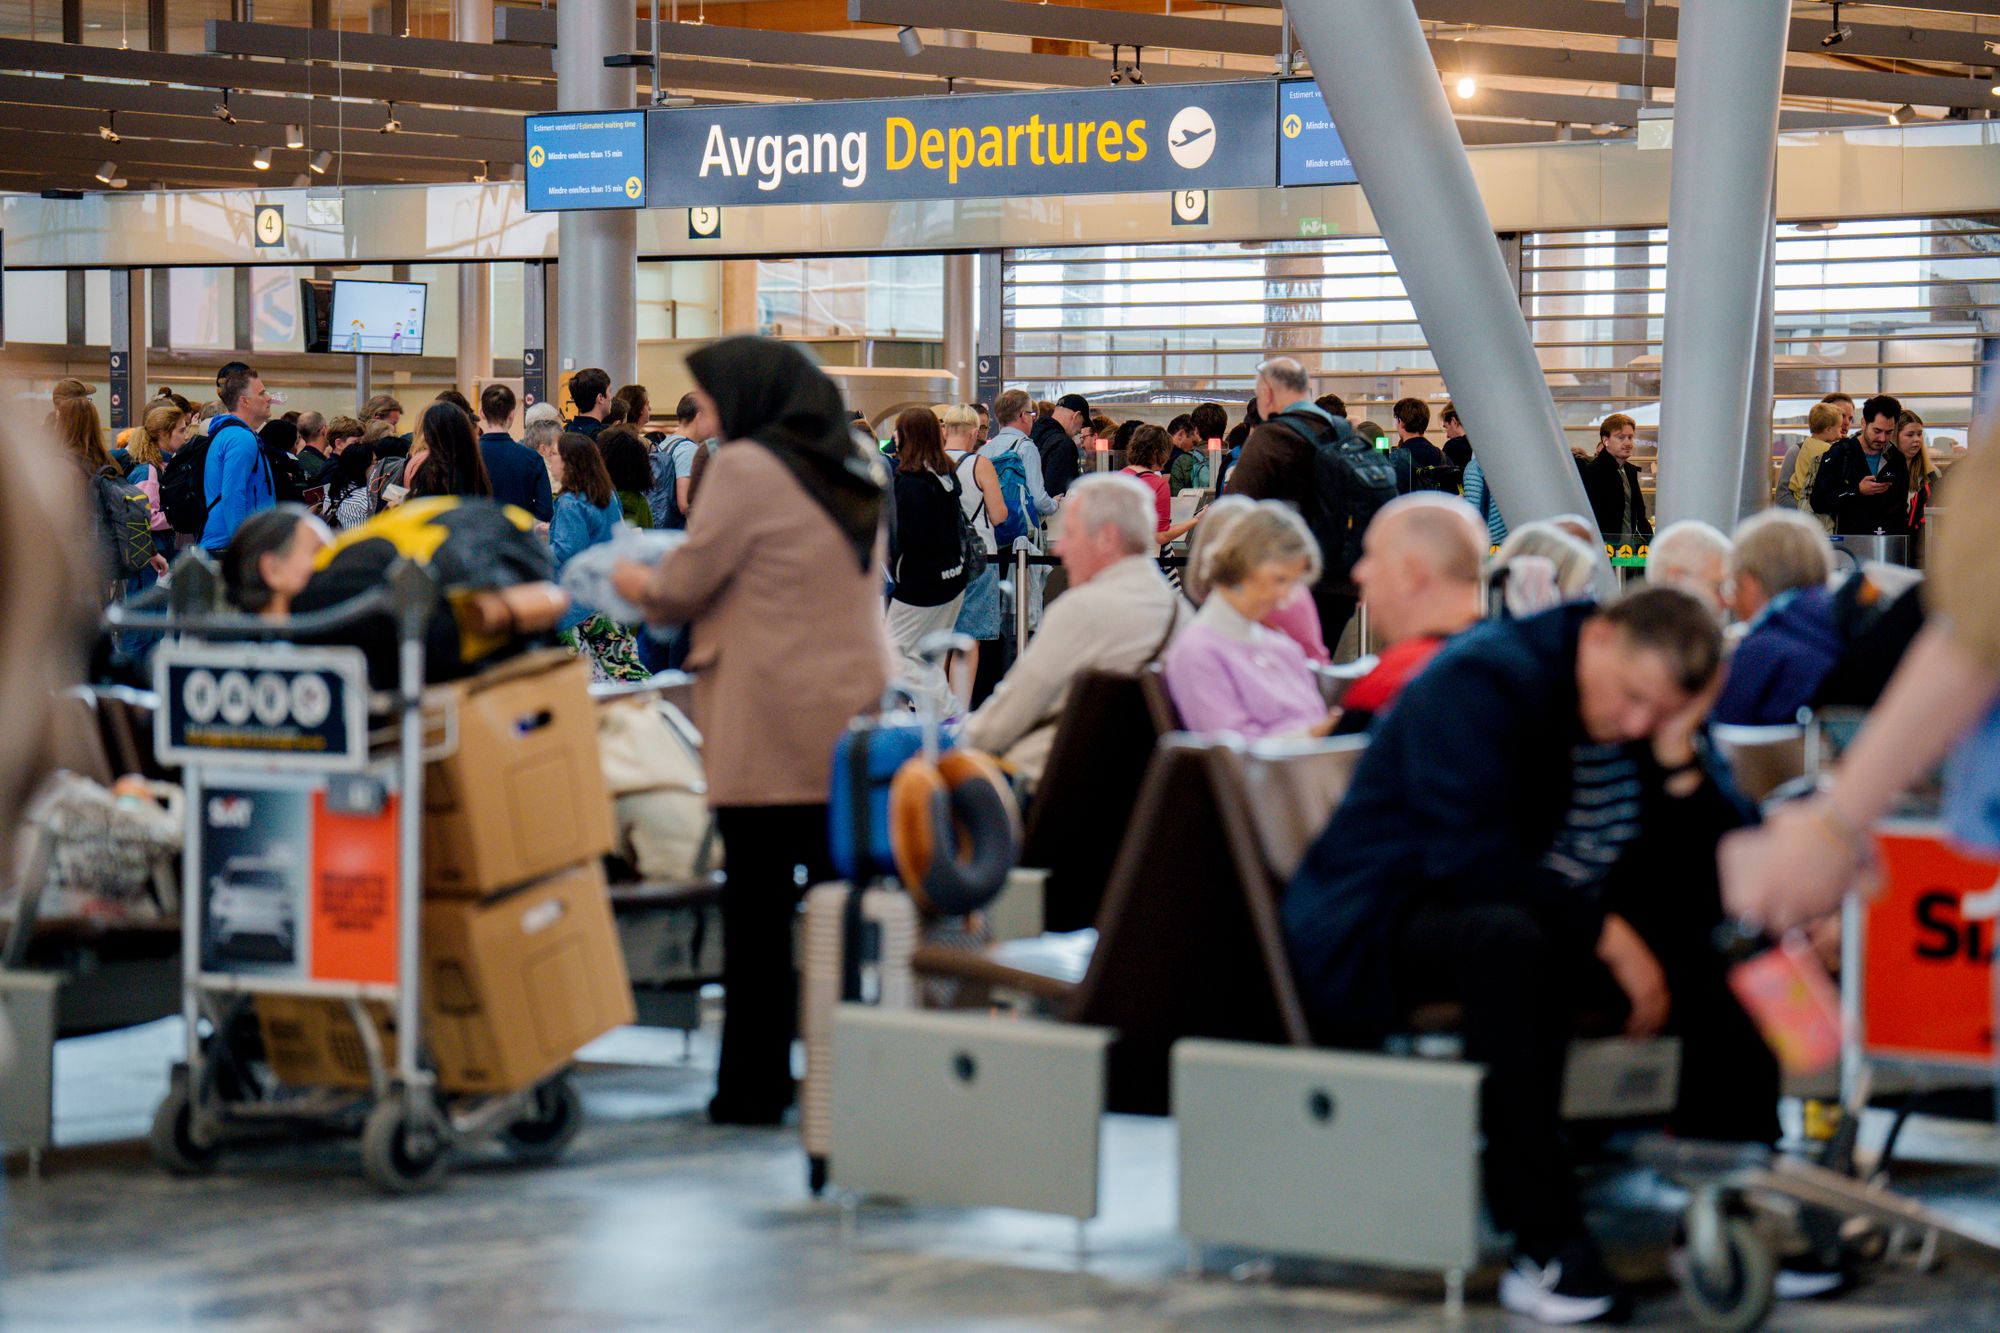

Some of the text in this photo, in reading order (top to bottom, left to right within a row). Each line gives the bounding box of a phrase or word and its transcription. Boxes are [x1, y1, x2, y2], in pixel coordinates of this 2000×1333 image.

[1289, 91, 1314, 99] Estimert
[534, 124, 555, 132] Estimert
[555, 123, 576, 131] ventetid
[604, 121, 623, 130] waiting
[1305, 121, 1328, 130] Mindre
[548, 152, 567, 160] Mindre
[590, 150, 603, 158] than
[604, 150, 611, 158] 15
[611, 149, 623, 157] min
[699, 114, 1147, 190] Avgang Departures
[1305, 159, 1328, 168] Mindre
[548, 187, 568, 195] Mindre
[590, 185, 604, 193] than
[604, 185, 611, 193] 15
[612, 184, 623, 192] min
[1185, 190, 1195, 209] 6
[700, 206, 709, 224] 5
[265, 215, 274, 233] 4
[1916, 892, 1988, 958] Si
